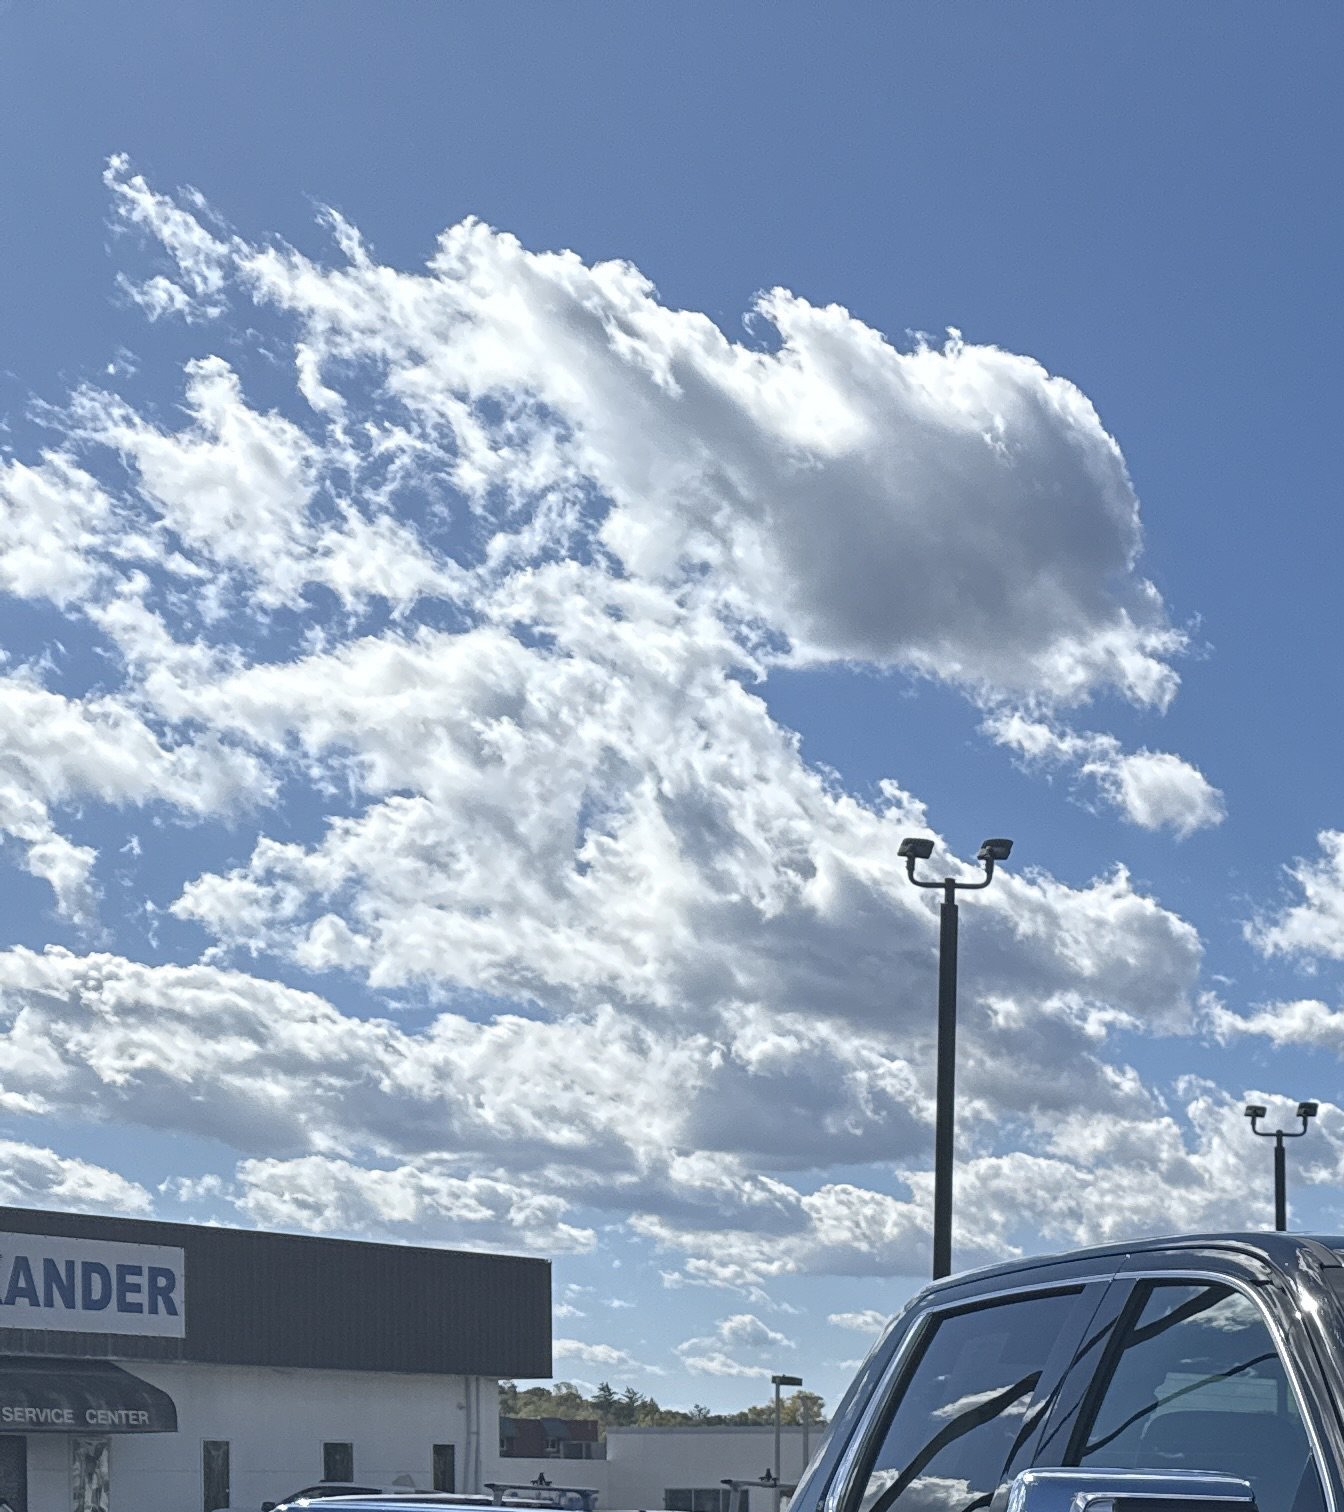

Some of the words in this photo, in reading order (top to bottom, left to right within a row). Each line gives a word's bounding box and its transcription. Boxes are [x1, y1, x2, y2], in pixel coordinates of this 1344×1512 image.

[0, 1255, 179, 1316] ANDER
[1, 1406, 75, 1424] SERVICE
[85, 1408, 150, 1425] CENTER
